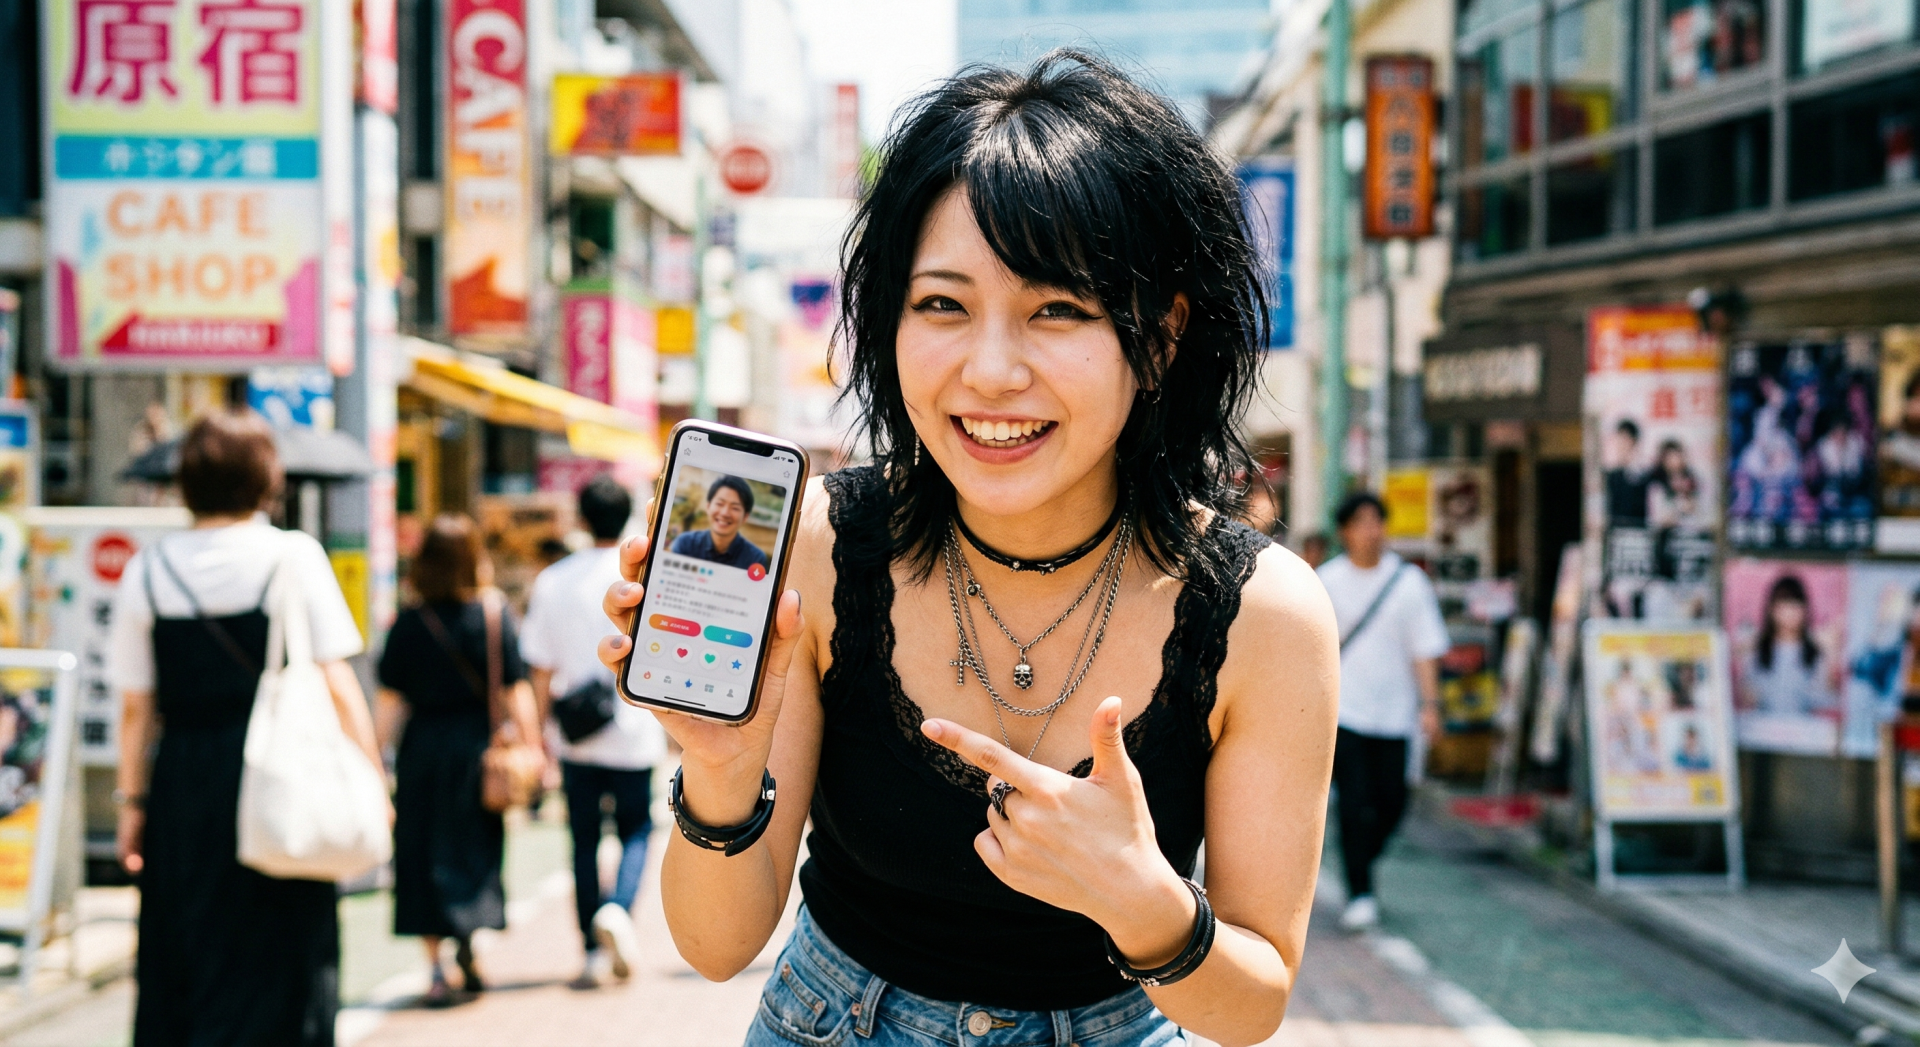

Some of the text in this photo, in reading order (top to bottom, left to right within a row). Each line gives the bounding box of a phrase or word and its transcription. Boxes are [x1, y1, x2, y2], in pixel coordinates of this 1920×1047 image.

[70, 0, 303, 104] 原宿
[453, 11, 524, 224] CAFE
[106, 190, 269, 240] CAFE
[105, 252, 278, 302] SHOP
